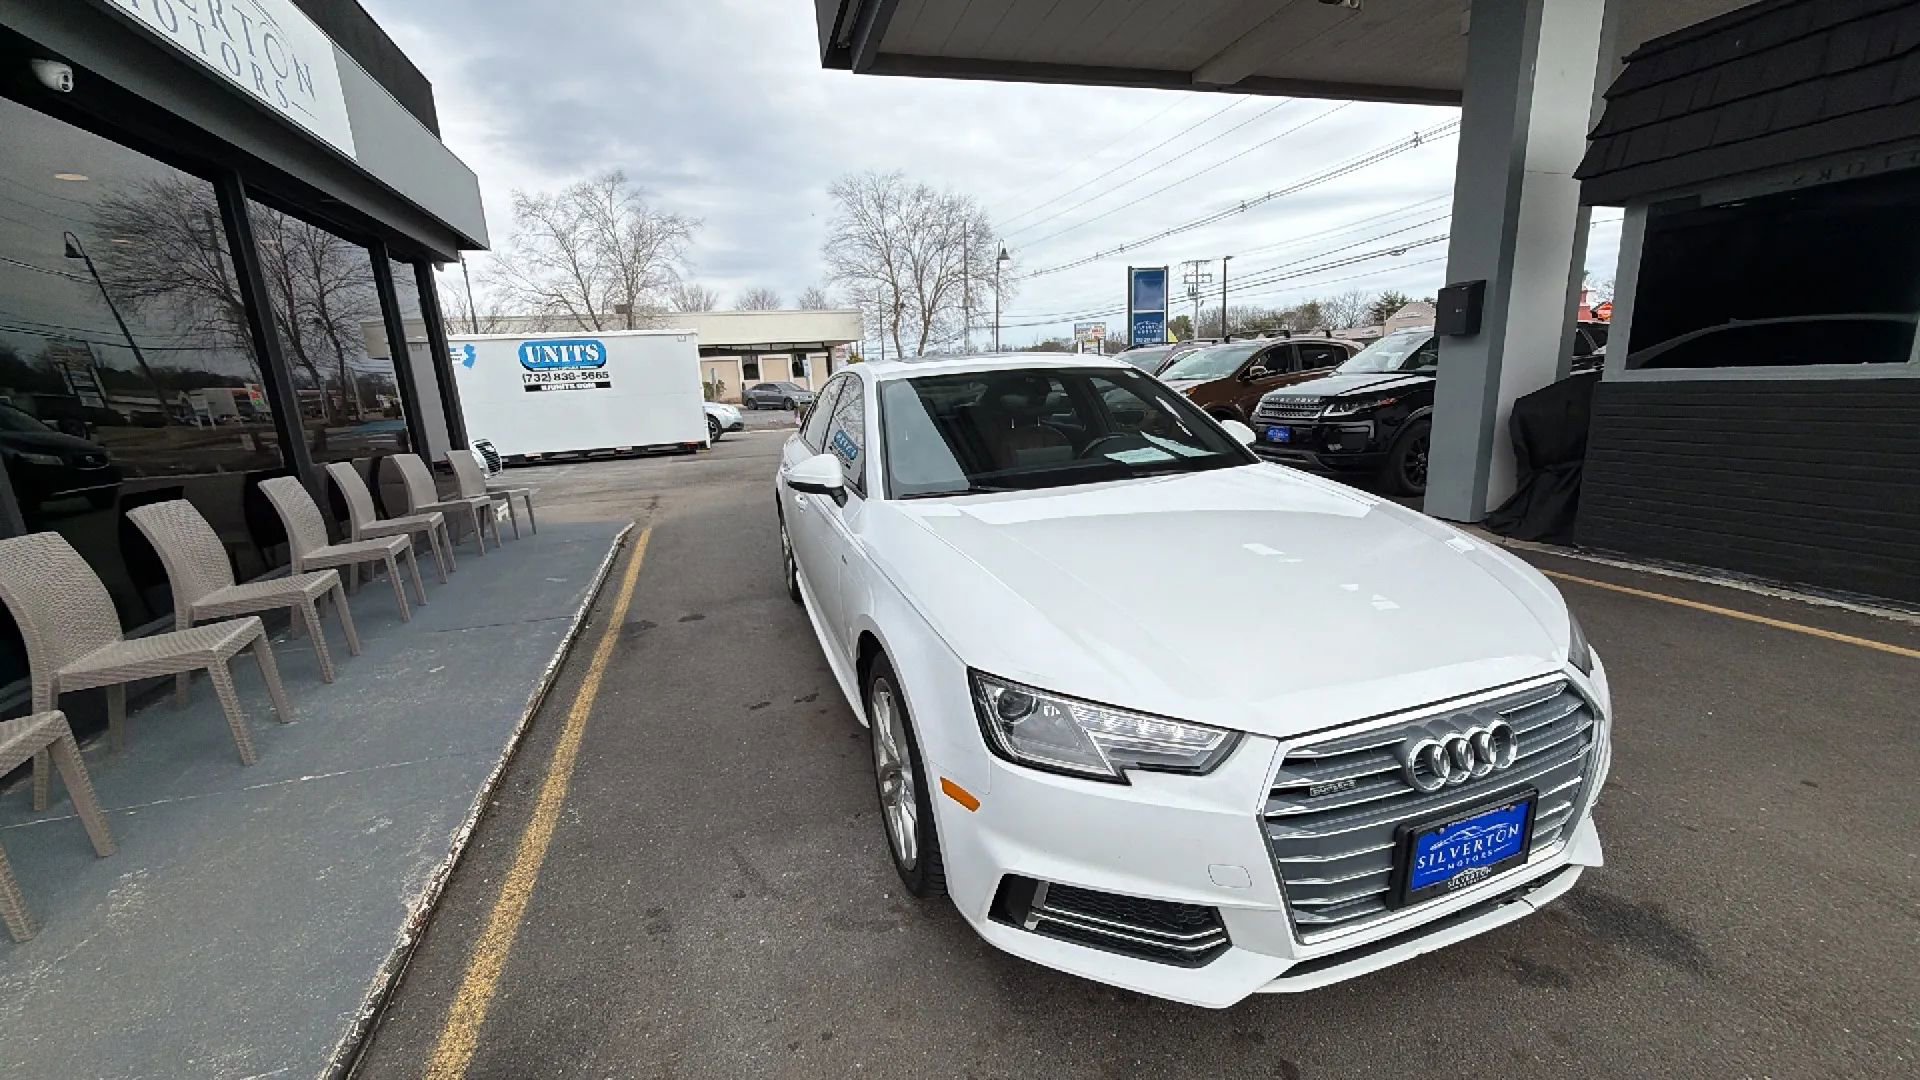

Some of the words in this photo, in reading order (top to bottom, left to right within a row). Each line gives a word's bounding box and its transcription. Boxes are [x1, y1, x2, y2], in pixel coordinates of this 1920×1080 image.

[131, 0, 289, 109] OTORS
[179, 0, 316, 101] RTON
[525, 344, 599, 363] UNITS
[522, 372, 551, 384] (732)
[1417, 823, 1520, 869] SILVERTON
[1447, 849, 1493, 871] MOTORS
